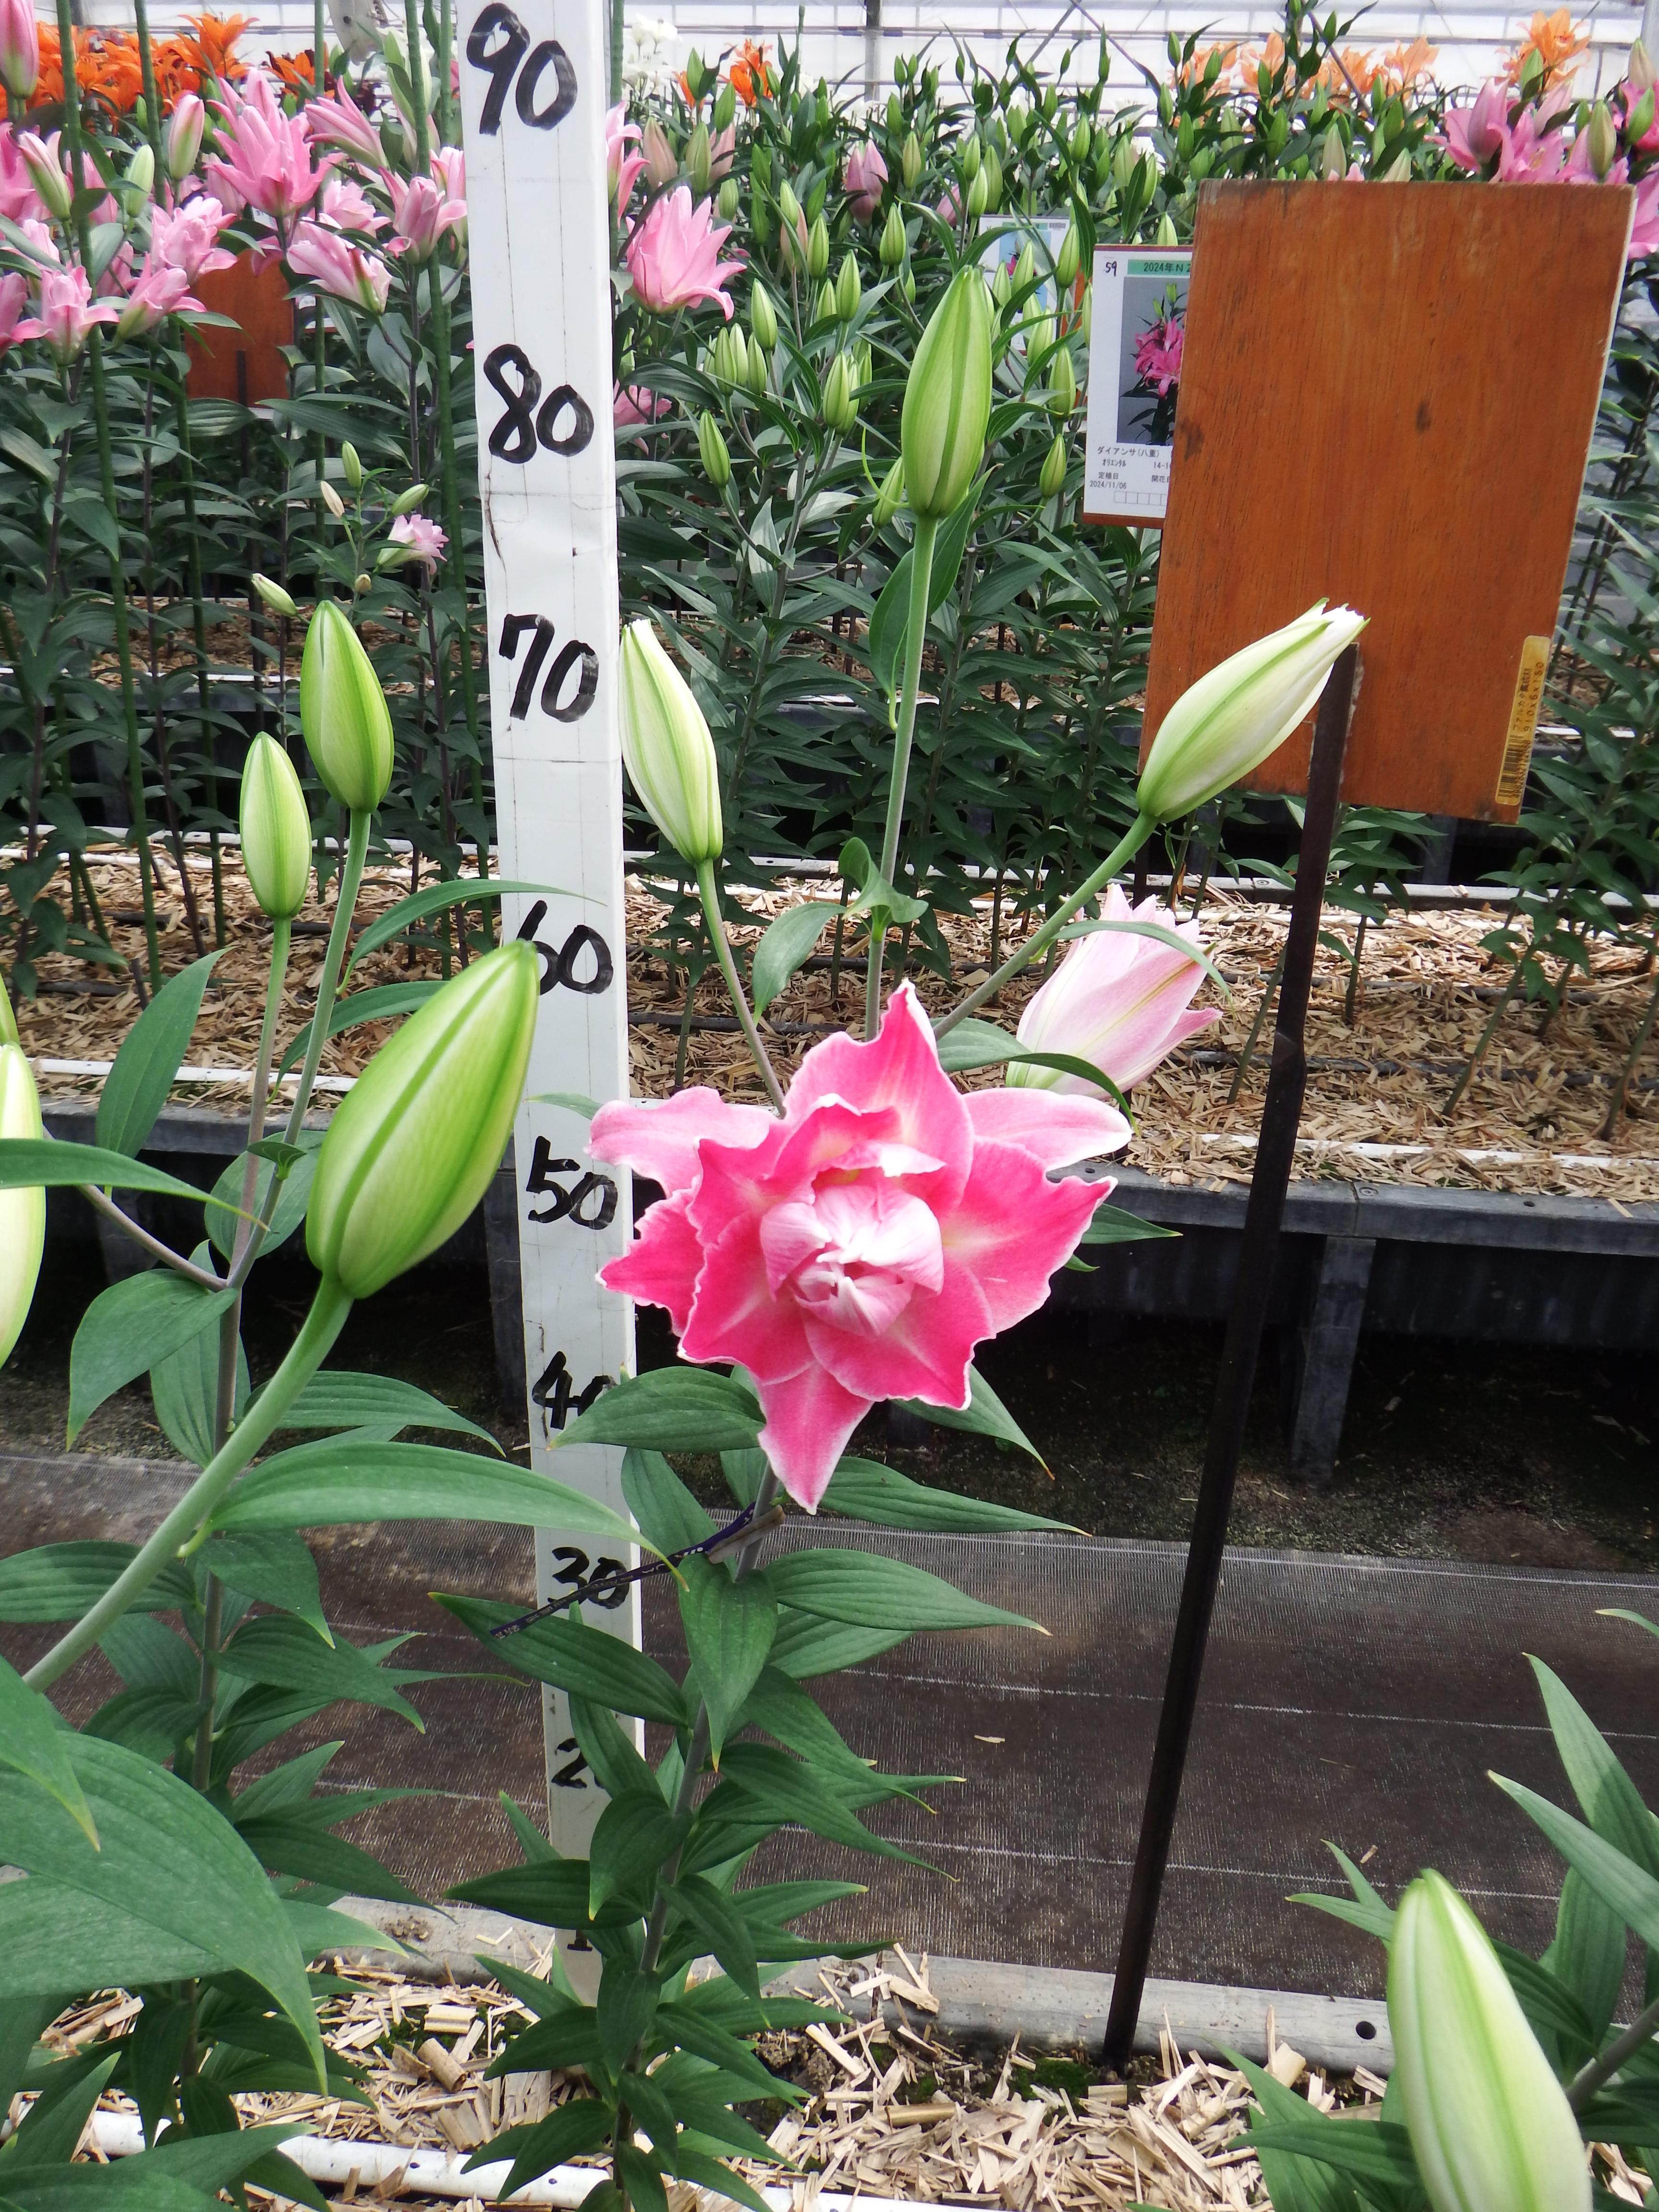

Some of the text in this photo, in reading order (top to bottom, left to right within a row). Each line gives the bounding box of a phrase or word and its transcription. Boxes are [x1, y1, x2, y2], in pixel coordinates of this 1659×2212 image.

[467, 3, 577, 135] 90
[1106, 261, 1117, 276] 59
[484, 344, 594, 464] 80
[1090, 481, 1127, 489] 2024/11/06
[499, 614, 599, 723] 70
[517, 900, 613, 995] 60
[526, 1136, 618, 1230] 50
[548, 1547, 630, 1610] 30
[551, 1738, 606, 1790] 2
